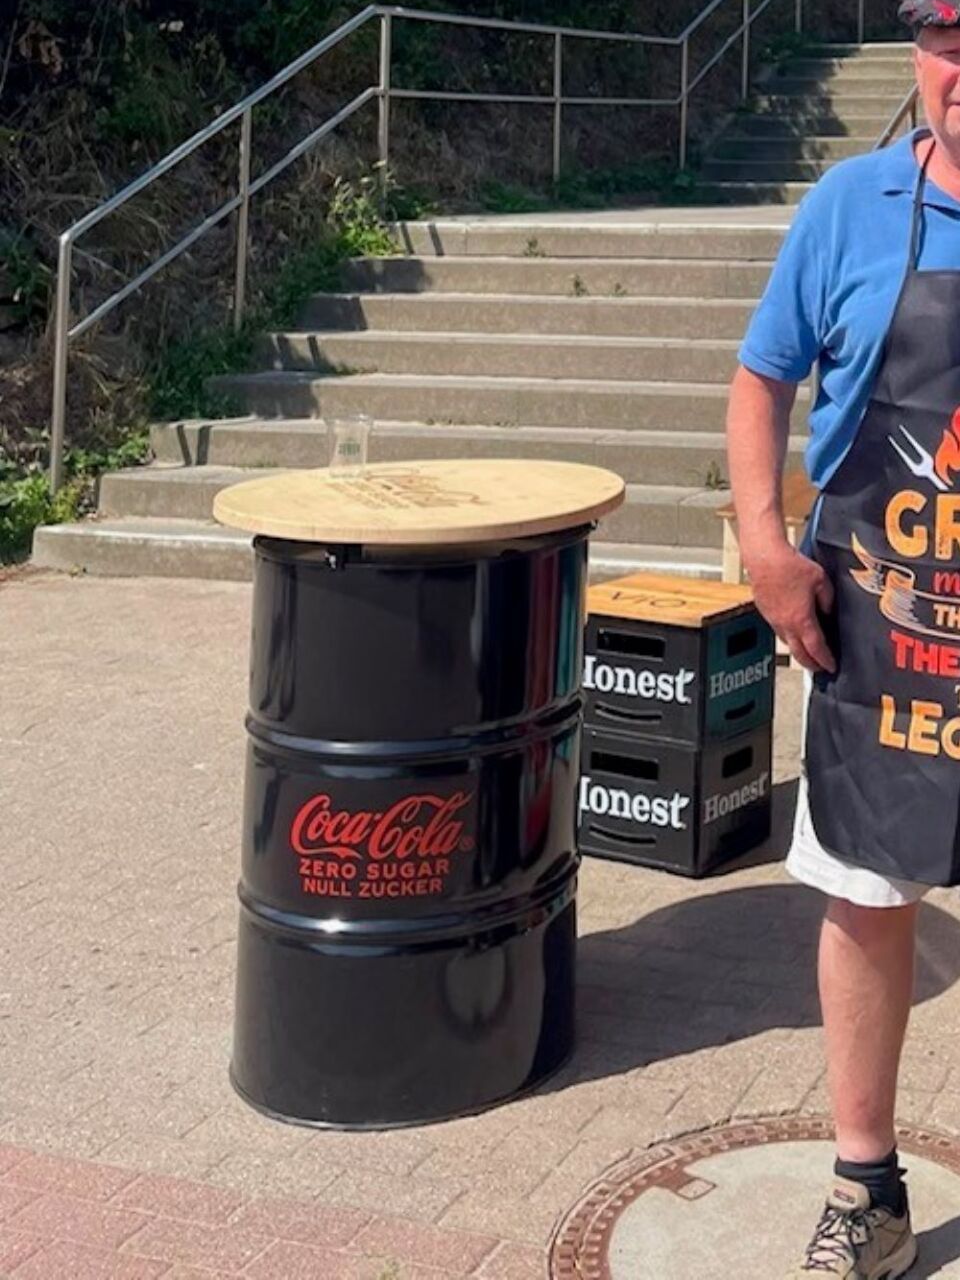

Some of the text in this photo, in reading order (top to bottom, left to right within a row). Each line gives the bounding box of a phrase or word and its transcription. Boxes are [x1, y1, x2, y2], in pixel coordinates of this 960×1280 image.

[709, 654, 773, 699] Honest
[704, 771, 769, 824] Honest
[300, 858, 450, 880] ZERO SUGAR
[303, 878, 443, 898] NULL ZUCKER
